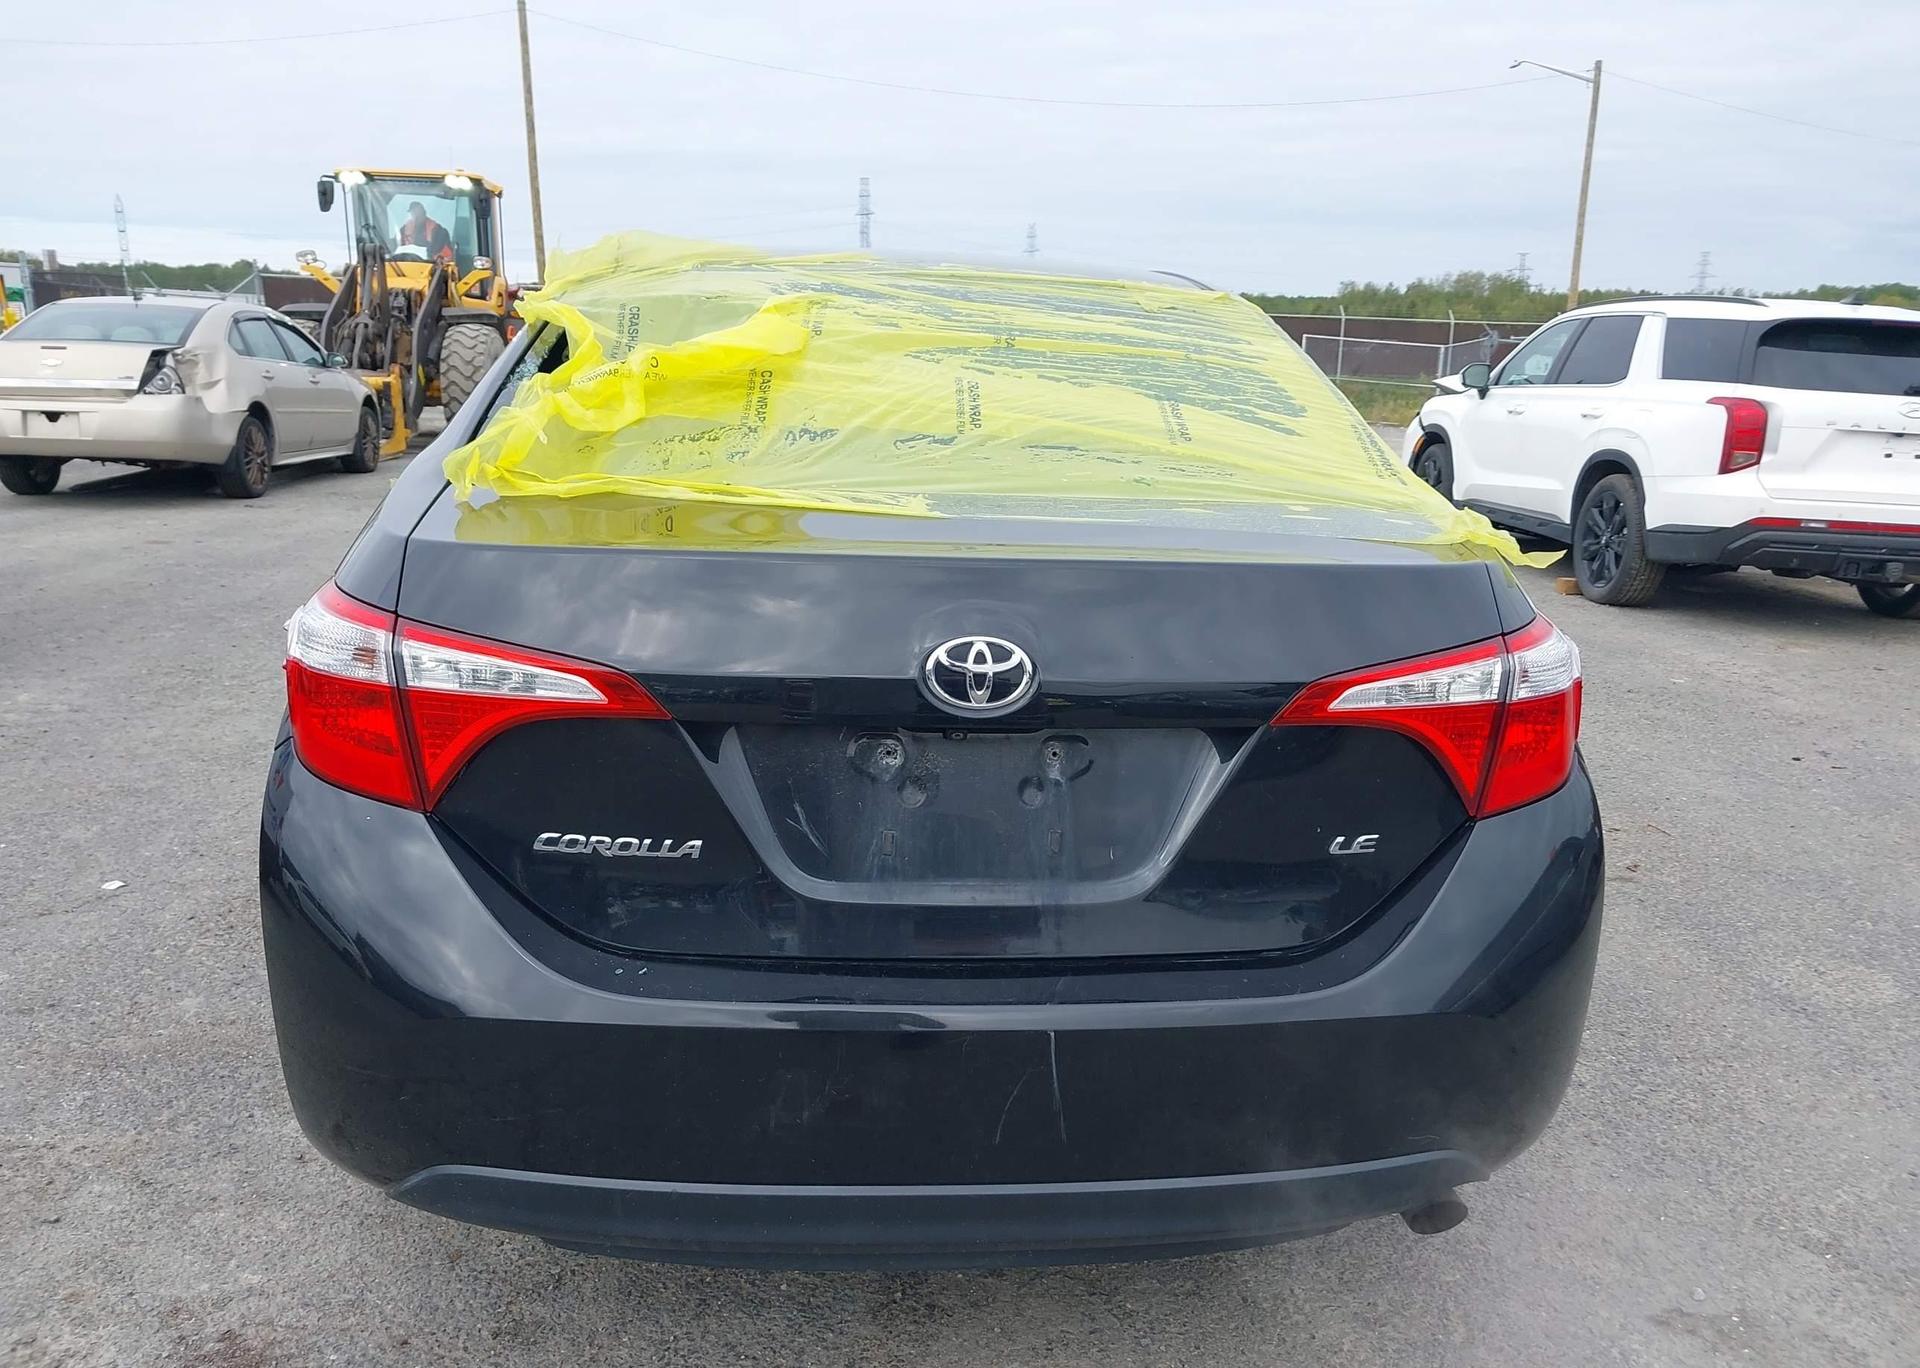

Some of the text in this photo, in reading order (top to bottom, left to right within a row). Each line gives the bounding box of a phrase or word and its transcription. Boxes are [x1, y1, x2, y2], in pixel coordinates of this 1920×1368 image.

[627, 306, 640, 342] CRASH
[533, 832, 703, 859] COROLLA
[1329, 835, 1380, 854] LE
